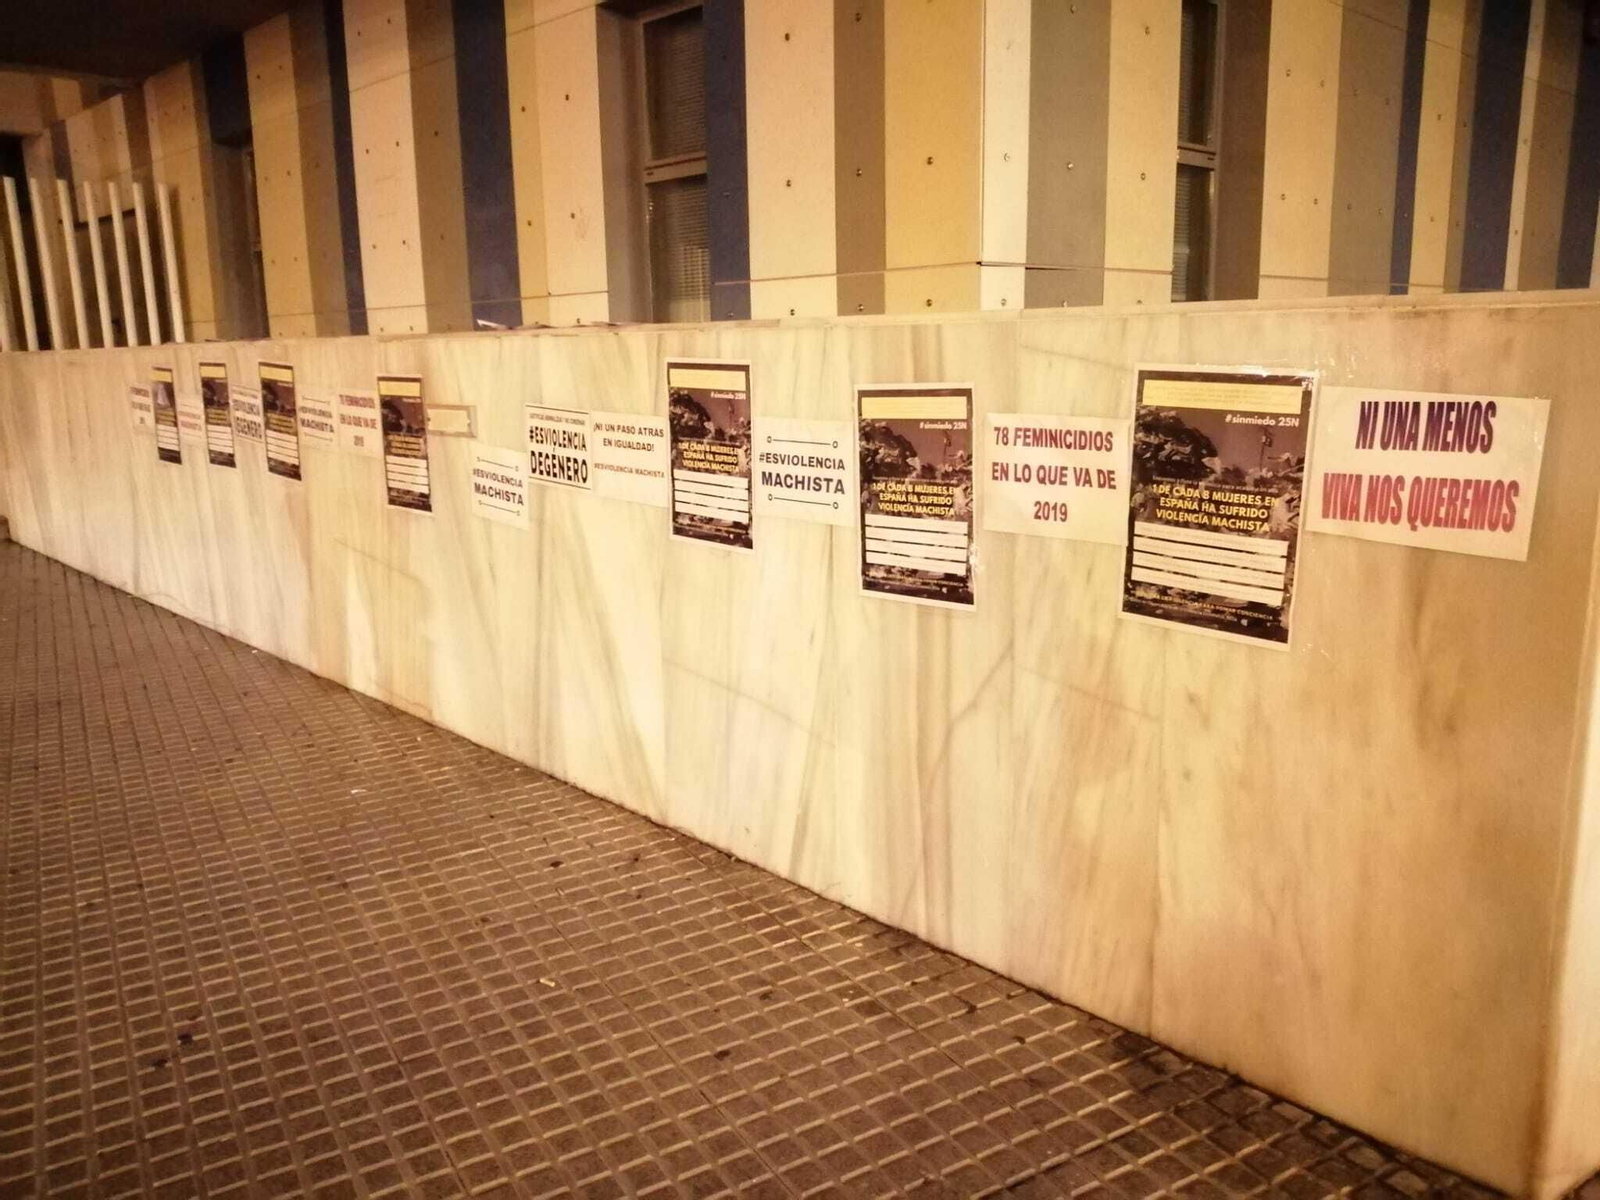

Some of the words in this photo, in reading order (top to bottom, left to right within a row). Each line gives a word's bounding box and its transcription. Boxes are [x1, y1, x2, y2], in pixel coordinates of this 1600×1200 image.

[604, 424, 615, 432] UN
[616, 424, 635, 434] PASO
[638, 427, 664, 438] ATRAS
[1225, 414, 1275, 426] #sinmiedo
[1278, 418, 1299, 428] 25N
[1355, 401, 1379, 450] NI
[1380, 402, 1421, 451] UNA
[1422, 401, 1496, 454] MENOS
[529, 426, 587, 452] #ESVIOLENCIA
[603, 438, 613, 447] EN
[614, 440, 654, 452] IGUALDAD!
[994, 426, 1009, 446] 78
[1013, 428, 1113, 452] FEMINICIDIOS
[759, 452, 845, 470] #ESVIOLENCIA
[473, 468, 523, 488] #ESVIOLENCIA
[761, 471, 845, 494] MACHISTA
[992, 462, 1009, 481] EN
[1014, 464, 1031, 483] LO
[1037, 465, 1068, 486] QUE
[1073, 467, 1093, 488] VA
[1097, 469, 1116, 490] DE
[474, 483, 524, 506] MACHISTA
[915, 484, 946, 494] MUJERES
[1158, 485, 1170, 495] DE
[1173, 486, 1200, 498] CADA
[1202, 490, 1210, 500] 8
[1212, 491, 1261, 505] MUJERES
[915, 504, 955, 516] MACHISTA
[1034, 501, 1068, 522] 2019
[1160, 497, 1199, 511] ESPAÑA
[1202, 502, 1216, 513] HA
[1220, 505, 1268, 519] SUFRIDO
[1322, 472, 1363, 522] VIVA
[1364, 474, 1405, 526] NOS
[1407, 476, 1520, 533] QUEREMOS
[1156, 509, 1209, 524] VIOLENCIA
[1212, 517, 1270, 532] MACHISTA
